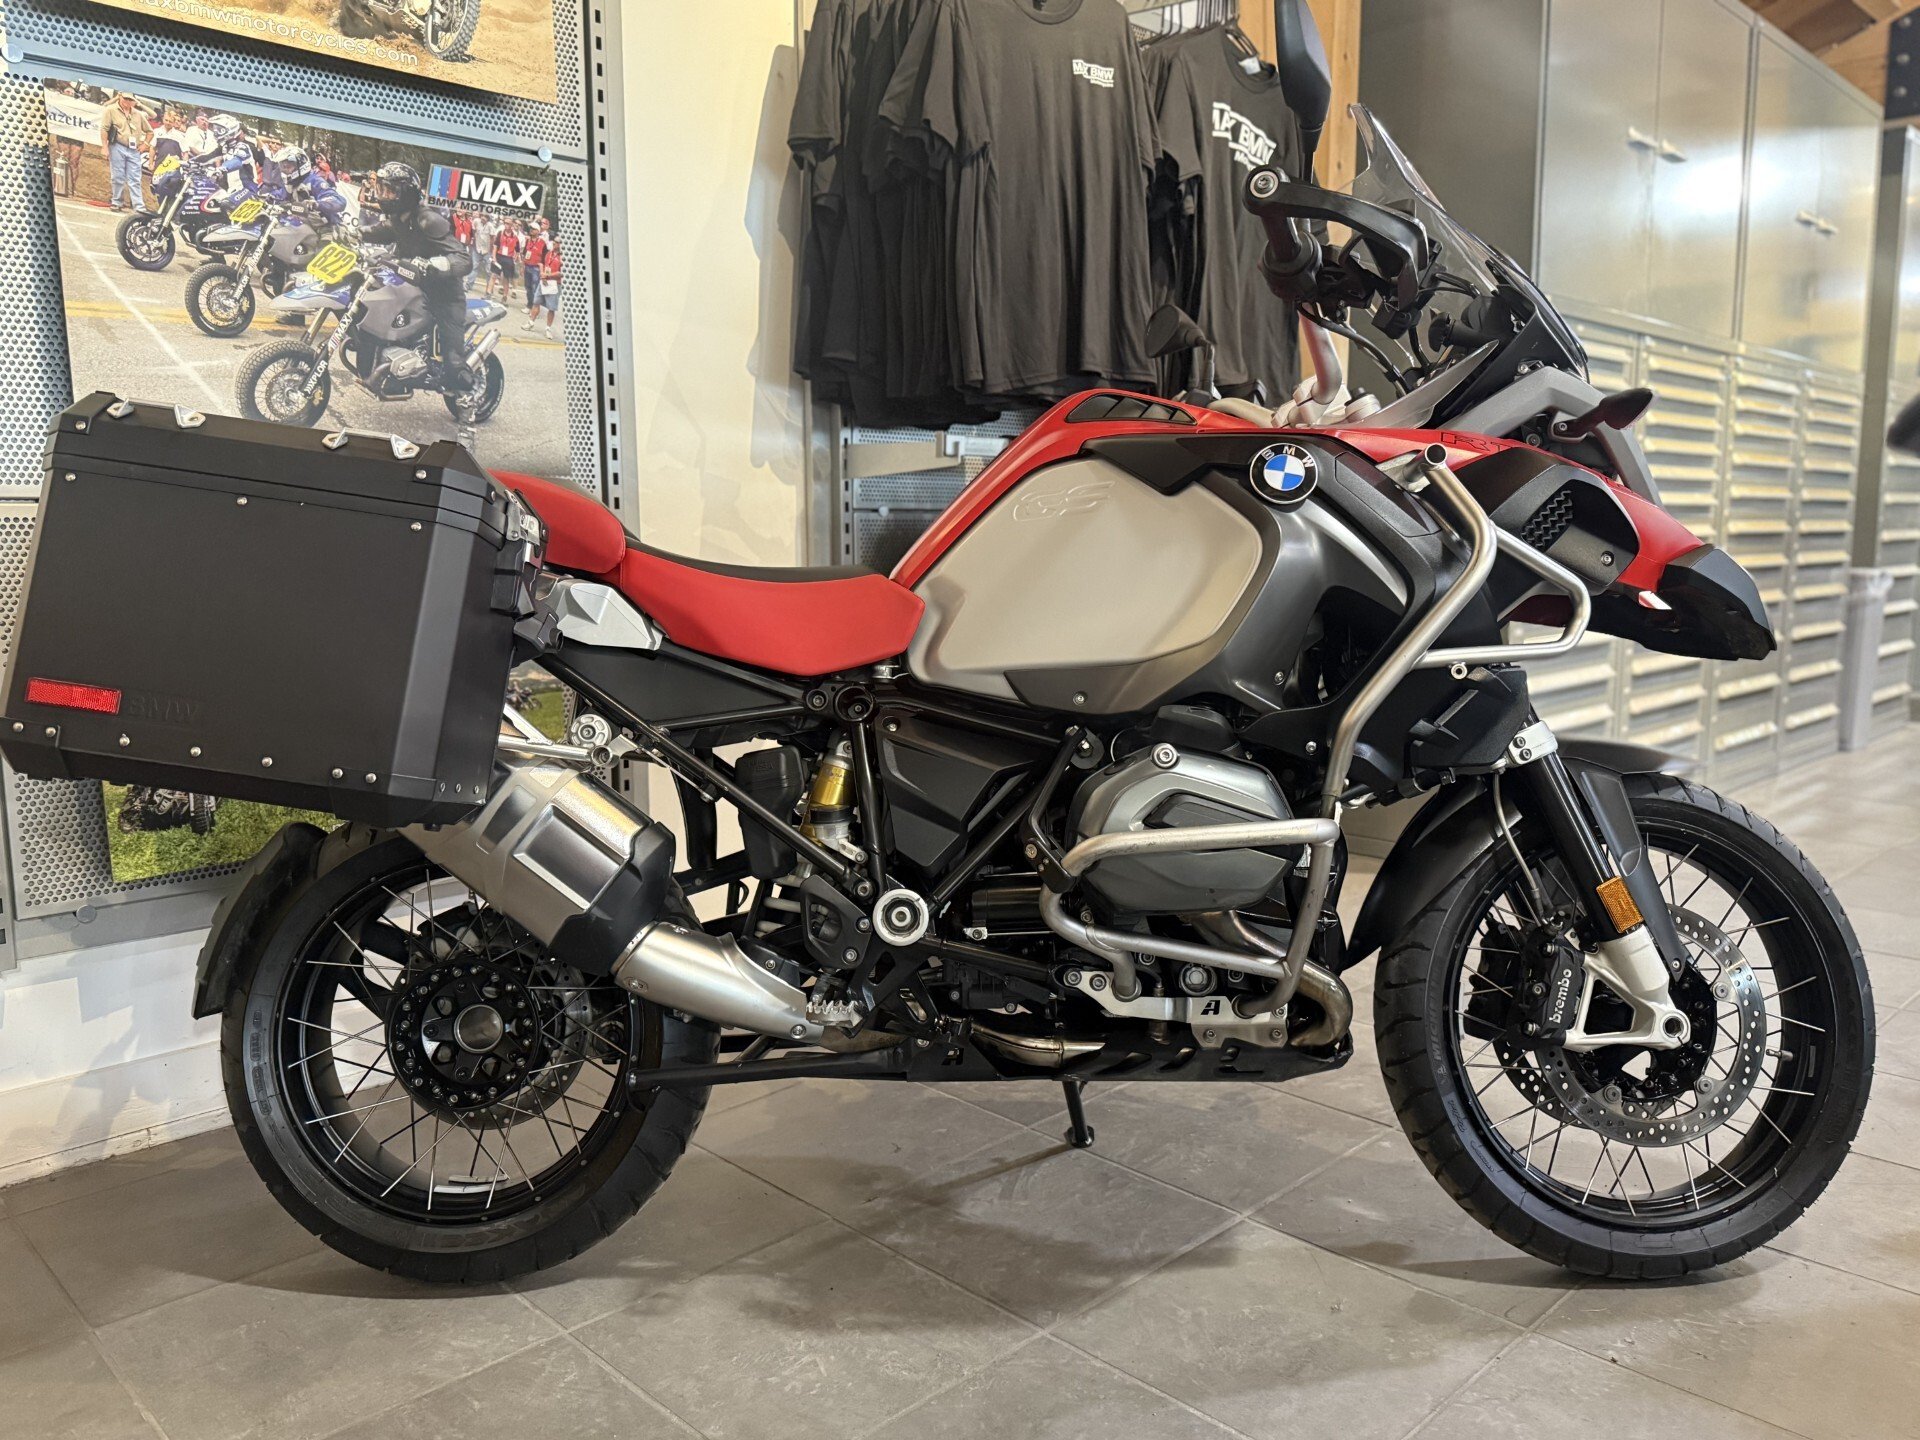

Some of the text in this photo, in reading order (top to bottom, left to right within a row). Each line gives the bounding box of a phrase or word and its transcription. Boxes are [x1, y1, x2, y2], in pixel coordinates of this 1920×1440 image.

[134, 0, 418, 66] axbmwmotorcycles.com
[1090, 66, 1114, 80] BMW
[46, 111, 91, 129] azette
[460, 173, 539, 210] MAX
[427, 196, 538, 219] BMW MOTORSPORT
[311, 245, 355, 279] 822
[336, 314, 353, 341] MAX
[1260, 445, 1316, 468] BMW
[1549, 968, 1572, 1023] brembo
